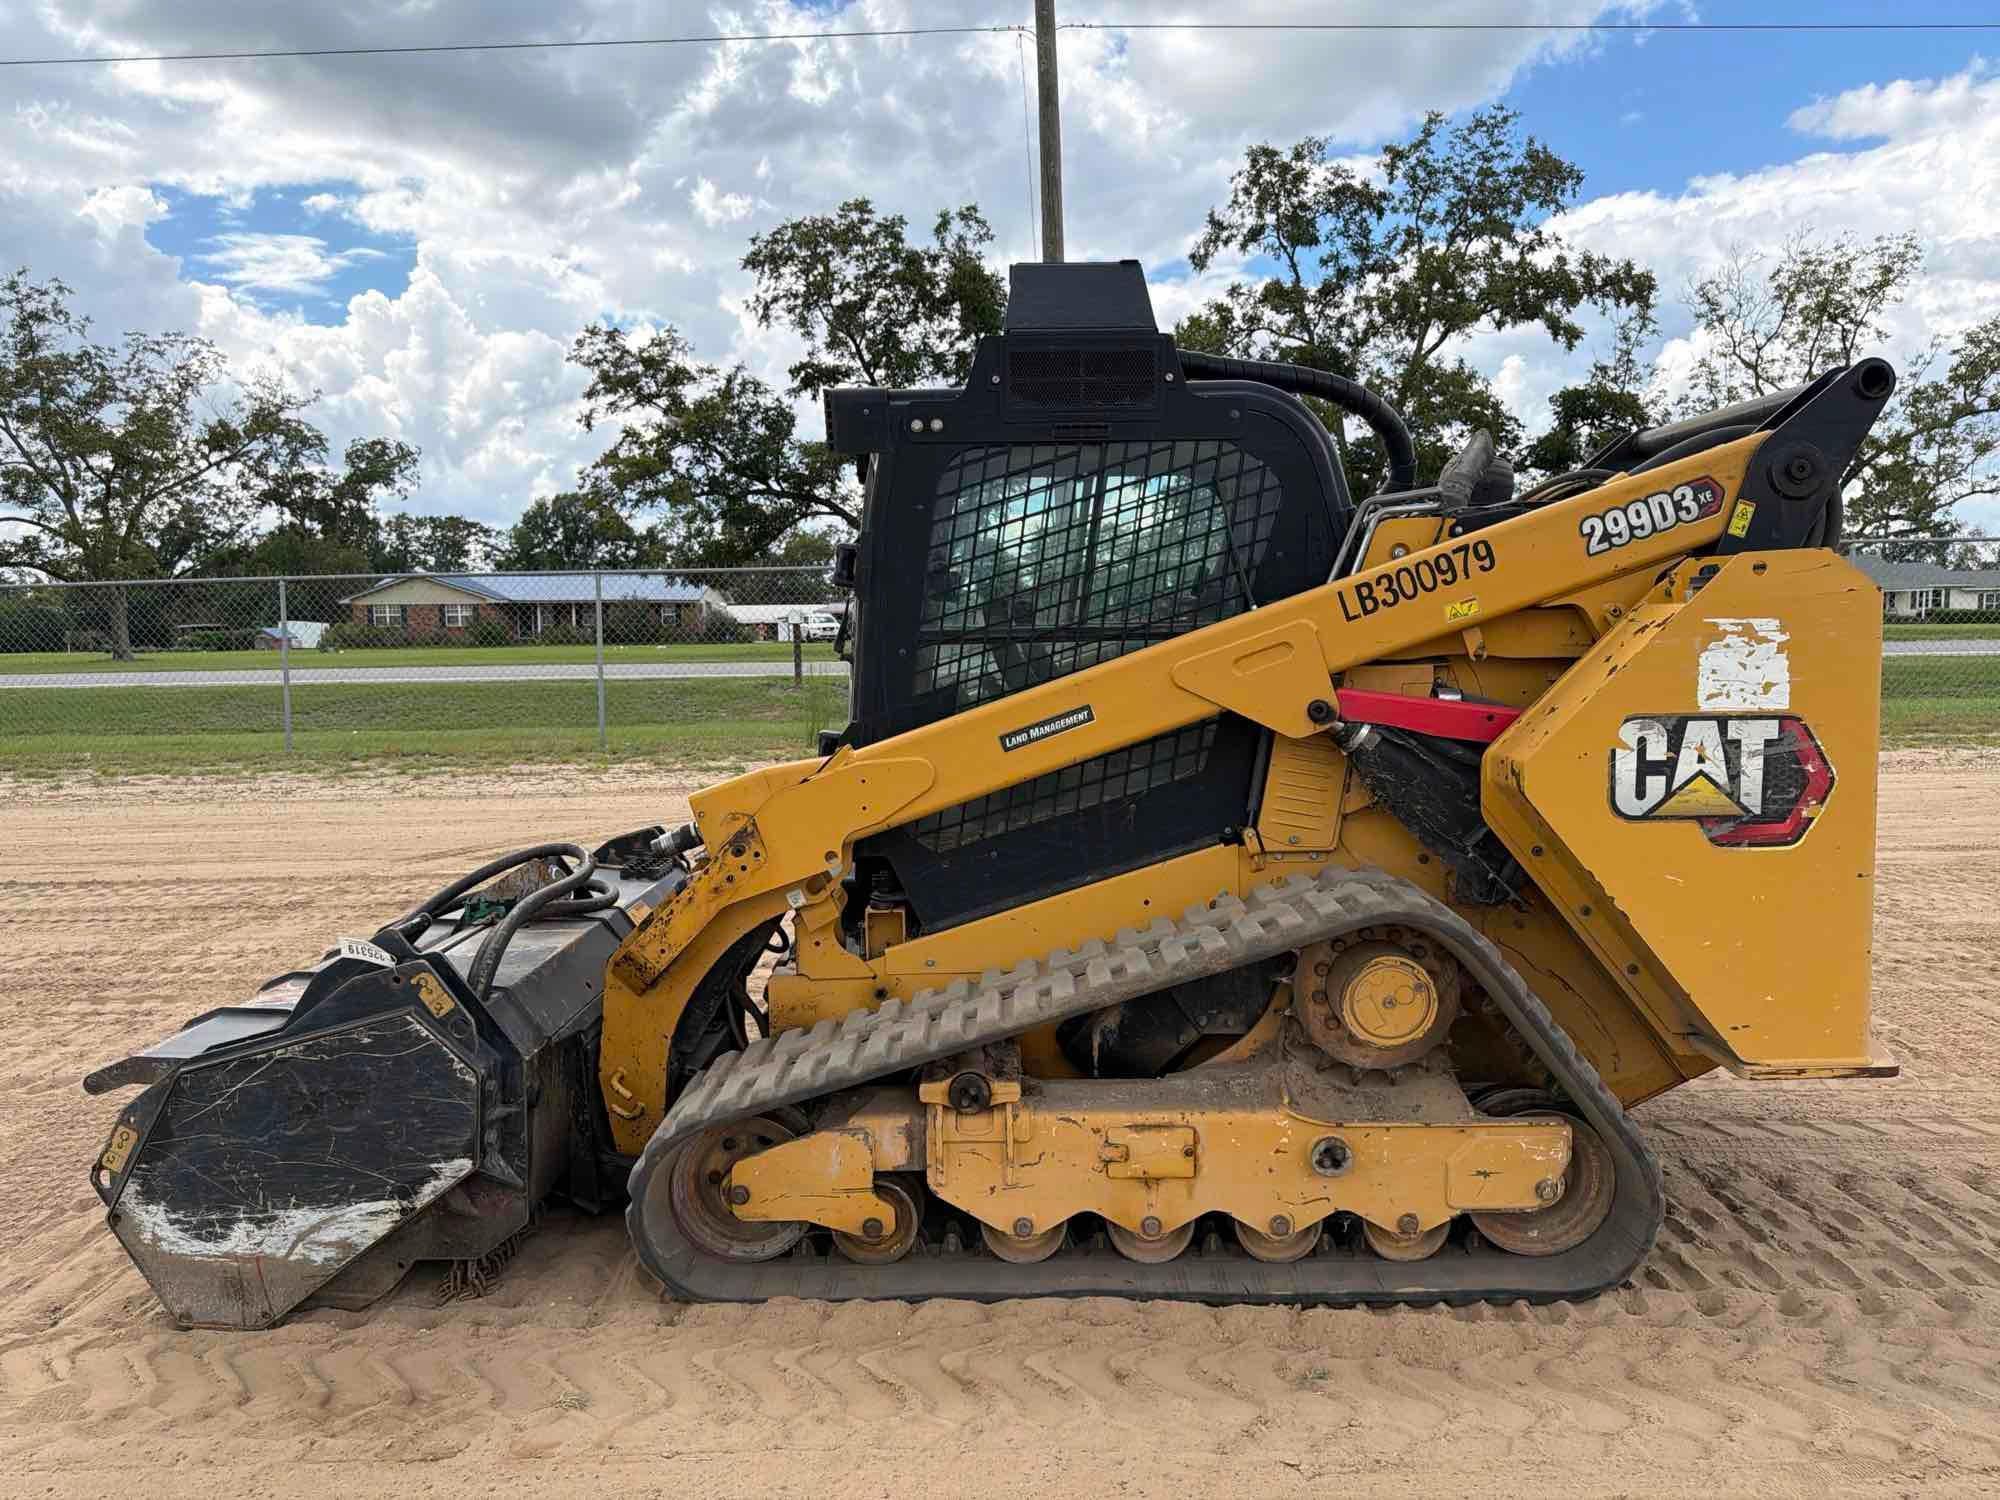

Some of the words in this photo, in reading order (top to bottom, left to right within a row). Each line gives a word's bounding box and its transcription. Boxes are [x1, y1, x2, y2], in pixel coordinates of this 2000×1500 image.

[1581, 486, 1699, 555] 299D3
[1698, 489, 1714, 505] XE
[1337, 540, 1496, 622] LB300979
[1615, 719, 1779, 816] CAT
